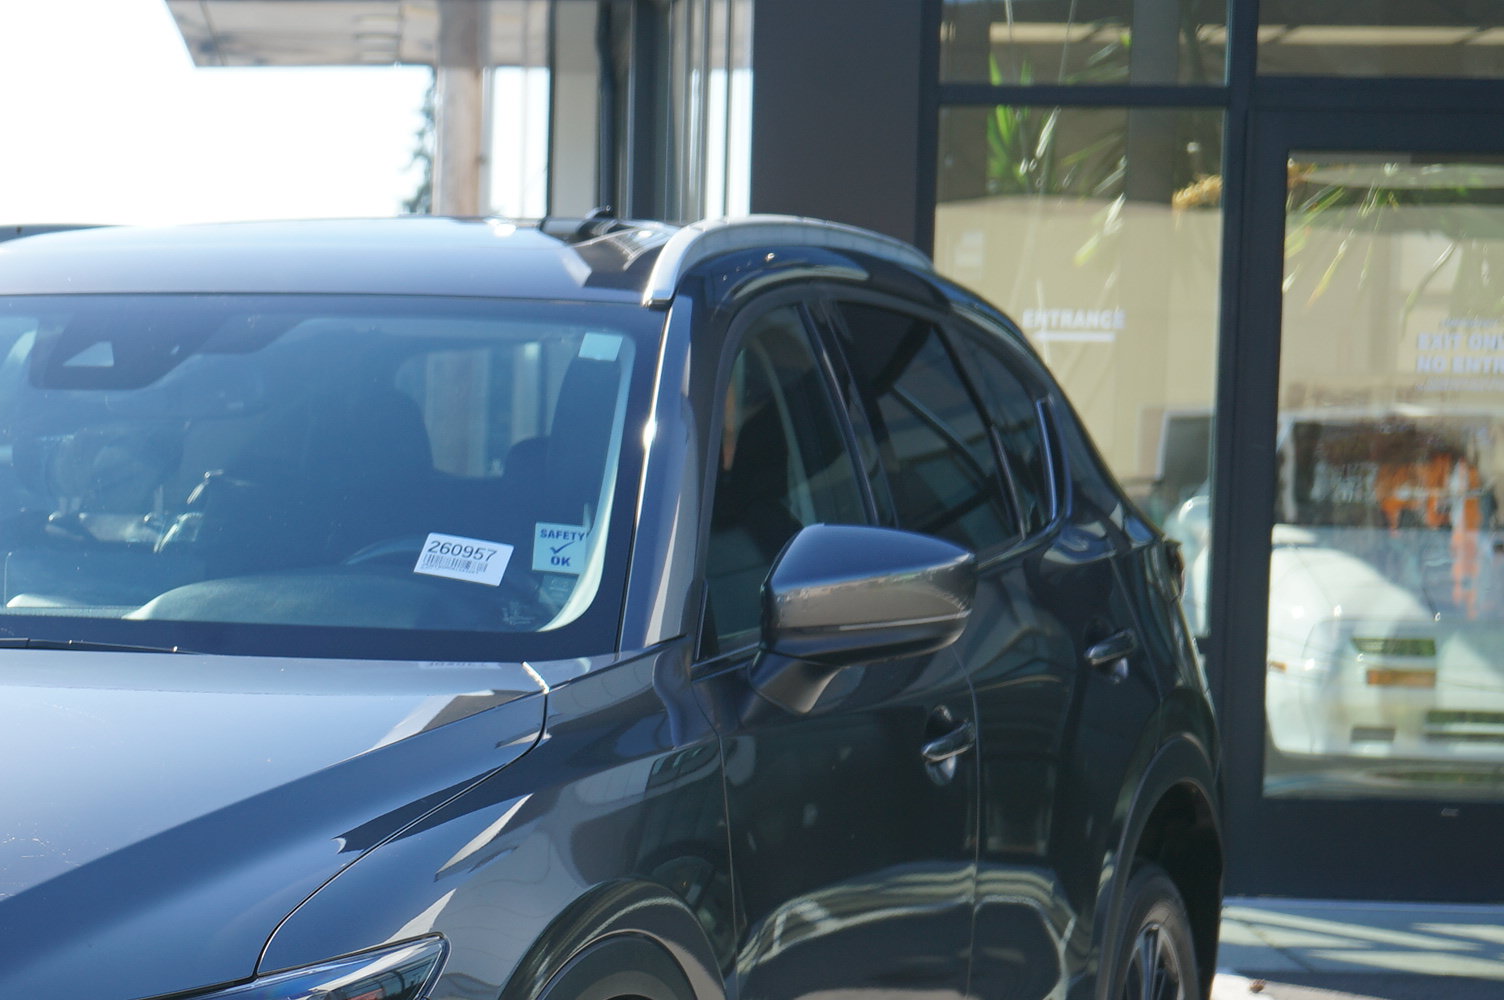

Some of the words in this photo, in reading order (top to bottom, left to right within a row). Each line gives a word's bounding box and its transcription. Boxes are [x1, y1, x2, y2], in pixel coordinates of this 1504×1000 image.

[1022, 310, 1127, 329] ENTRANCE
[1417, 333, 1462, 350] EXIT
[1416, 356, 1447, 373] NO
[539, 528, 587, 542] SAFETY
[428, 540, 497, 561] 260957
[550, 556, 571, 567] OK
